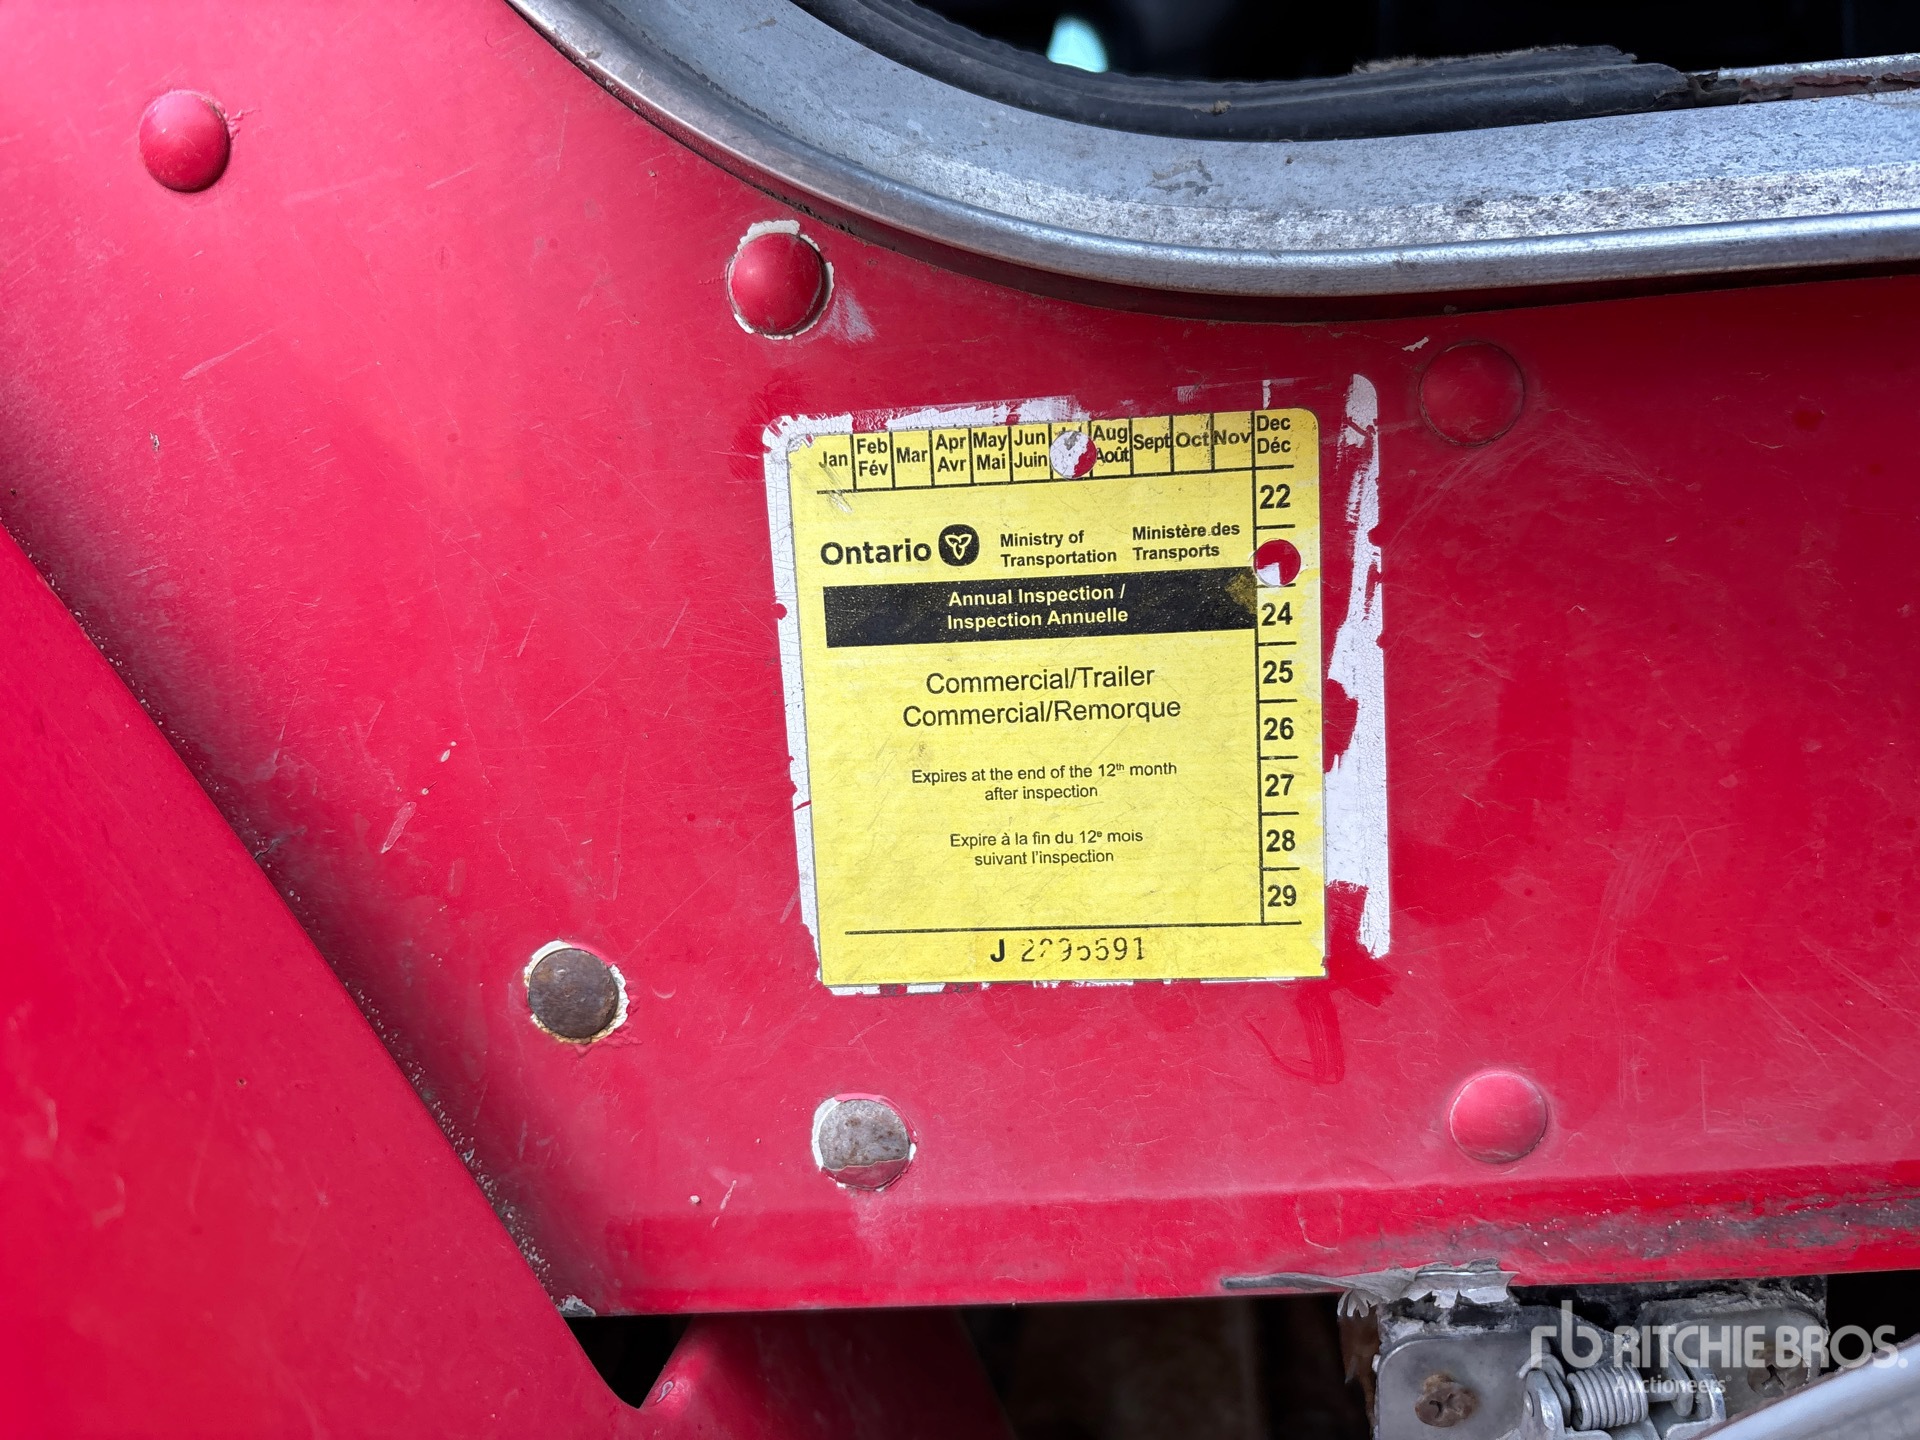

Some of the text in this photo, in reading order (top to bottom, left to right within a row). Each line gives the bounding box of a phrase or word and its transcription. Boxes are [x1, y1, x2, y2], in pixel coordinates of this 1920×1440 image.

[1257, 415, 1291, 432] Dec
[935, 433, 966, 453] Apr
[973, 432, 1007, 451] May
[1014, 430, 1046, 446] Jun
[1093, 425, 1128, 443] Aug
[1133, 434, 1172, 453] Sept
[1176, 433, 1209, 448] Oct
[1213, 430, 1250, 445] Nov
[857, 438, 888, 454] Feb
[896, 447, 928, 463] Mar
[1096, 446, 1130, 464] Août
[1257, 438, 1291, 454] Déc
[819, 451, 848, 468] Jan
[859, 460, 888, 476] Fév
[937, 457, 967, 472] Avr
[976, 454, 1006, 471] Mai
[1014, 452, 1048, 468] Juin
[1260, 484, 1291, 509] 22
[1000, 530, 1085, 549] Ministry of
[1132, 522, 1240, 541] Ministère des
[820, 538, 932, 566] Ontario
[1001, 549, 1117, 569] Transportation
[1132, 544, 1220, 563] Transports
[949, 584, 1126, 607] Annual Inspection /
[948, 607, 1128, 632] Inspection Annuelle
[1261, 602, 1293, 626] 24
[926, 666, 1155, 694] Commercial/Trailer
[1262, 660, 1293, 684] 25
[903, 700, 1181, 727] Commercial/Remorque
[1263, 717, 1294, 741] 26
[912, 762, 1177, 786] Expires at the end of the 12th month
[985, 784, 1098, 802] after inspection
[1264, 773, 1294, 797] 27
[950, 829, 1143, 849] Expire à la fin du 12e mois
[1266, 829, 1296, 852] 28
[975, 850, 1114, 866] suivant l'inspection
[1267, 885, 1297, 907] 29
[990, 938, 1005, 962] J
